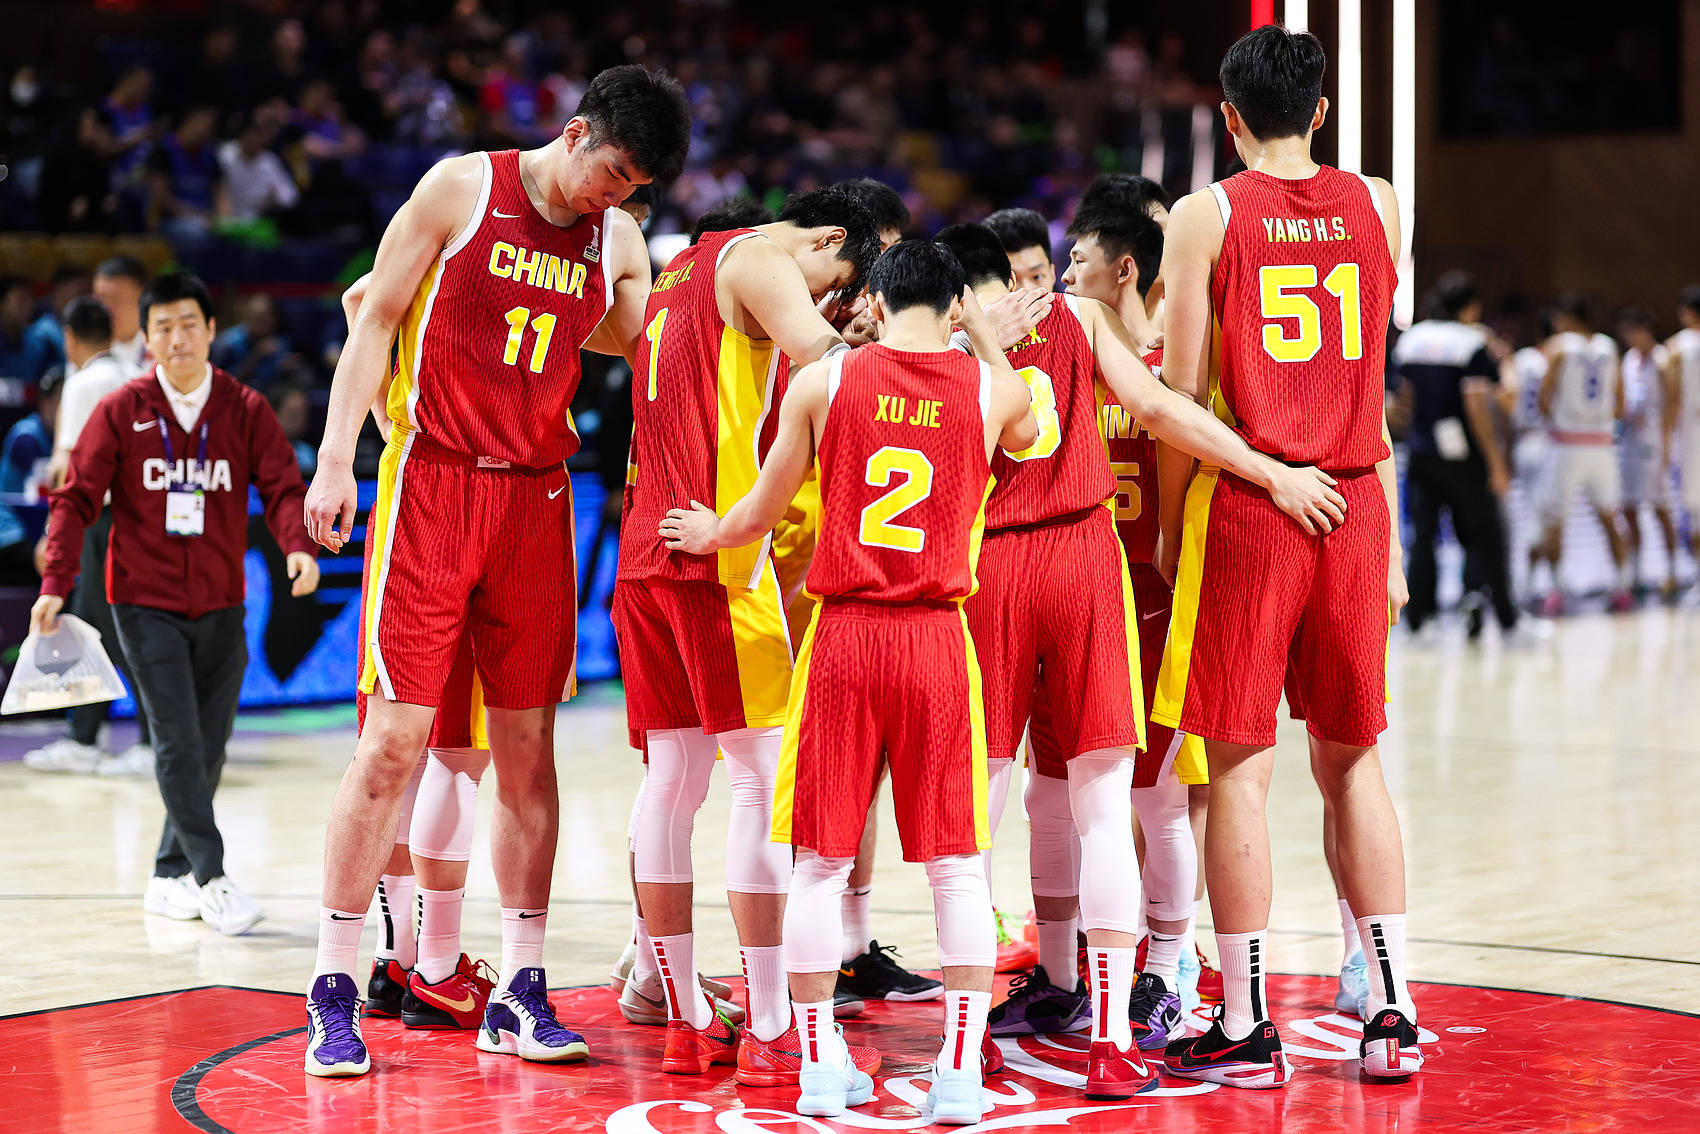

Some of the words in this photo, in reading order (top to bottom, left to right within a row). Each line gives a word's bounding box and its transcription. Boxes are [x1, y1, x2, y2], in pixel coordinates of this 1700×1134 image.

[1262, 217, 1312, 242] YANG
[1313, 216, 1352, 241] H.S.
[488, 241, 587, 299] CHINA
[503, 306, 557, 373] 11
[1259, 262, 1363, 363] 51
[646, 307, 669, 402] 1
[874, 394, 906, 424] XU
[908, 399, 944, 428] JIE
[143, 457, 232, 492] CHINA
[858, 445, 934, 553] 2
